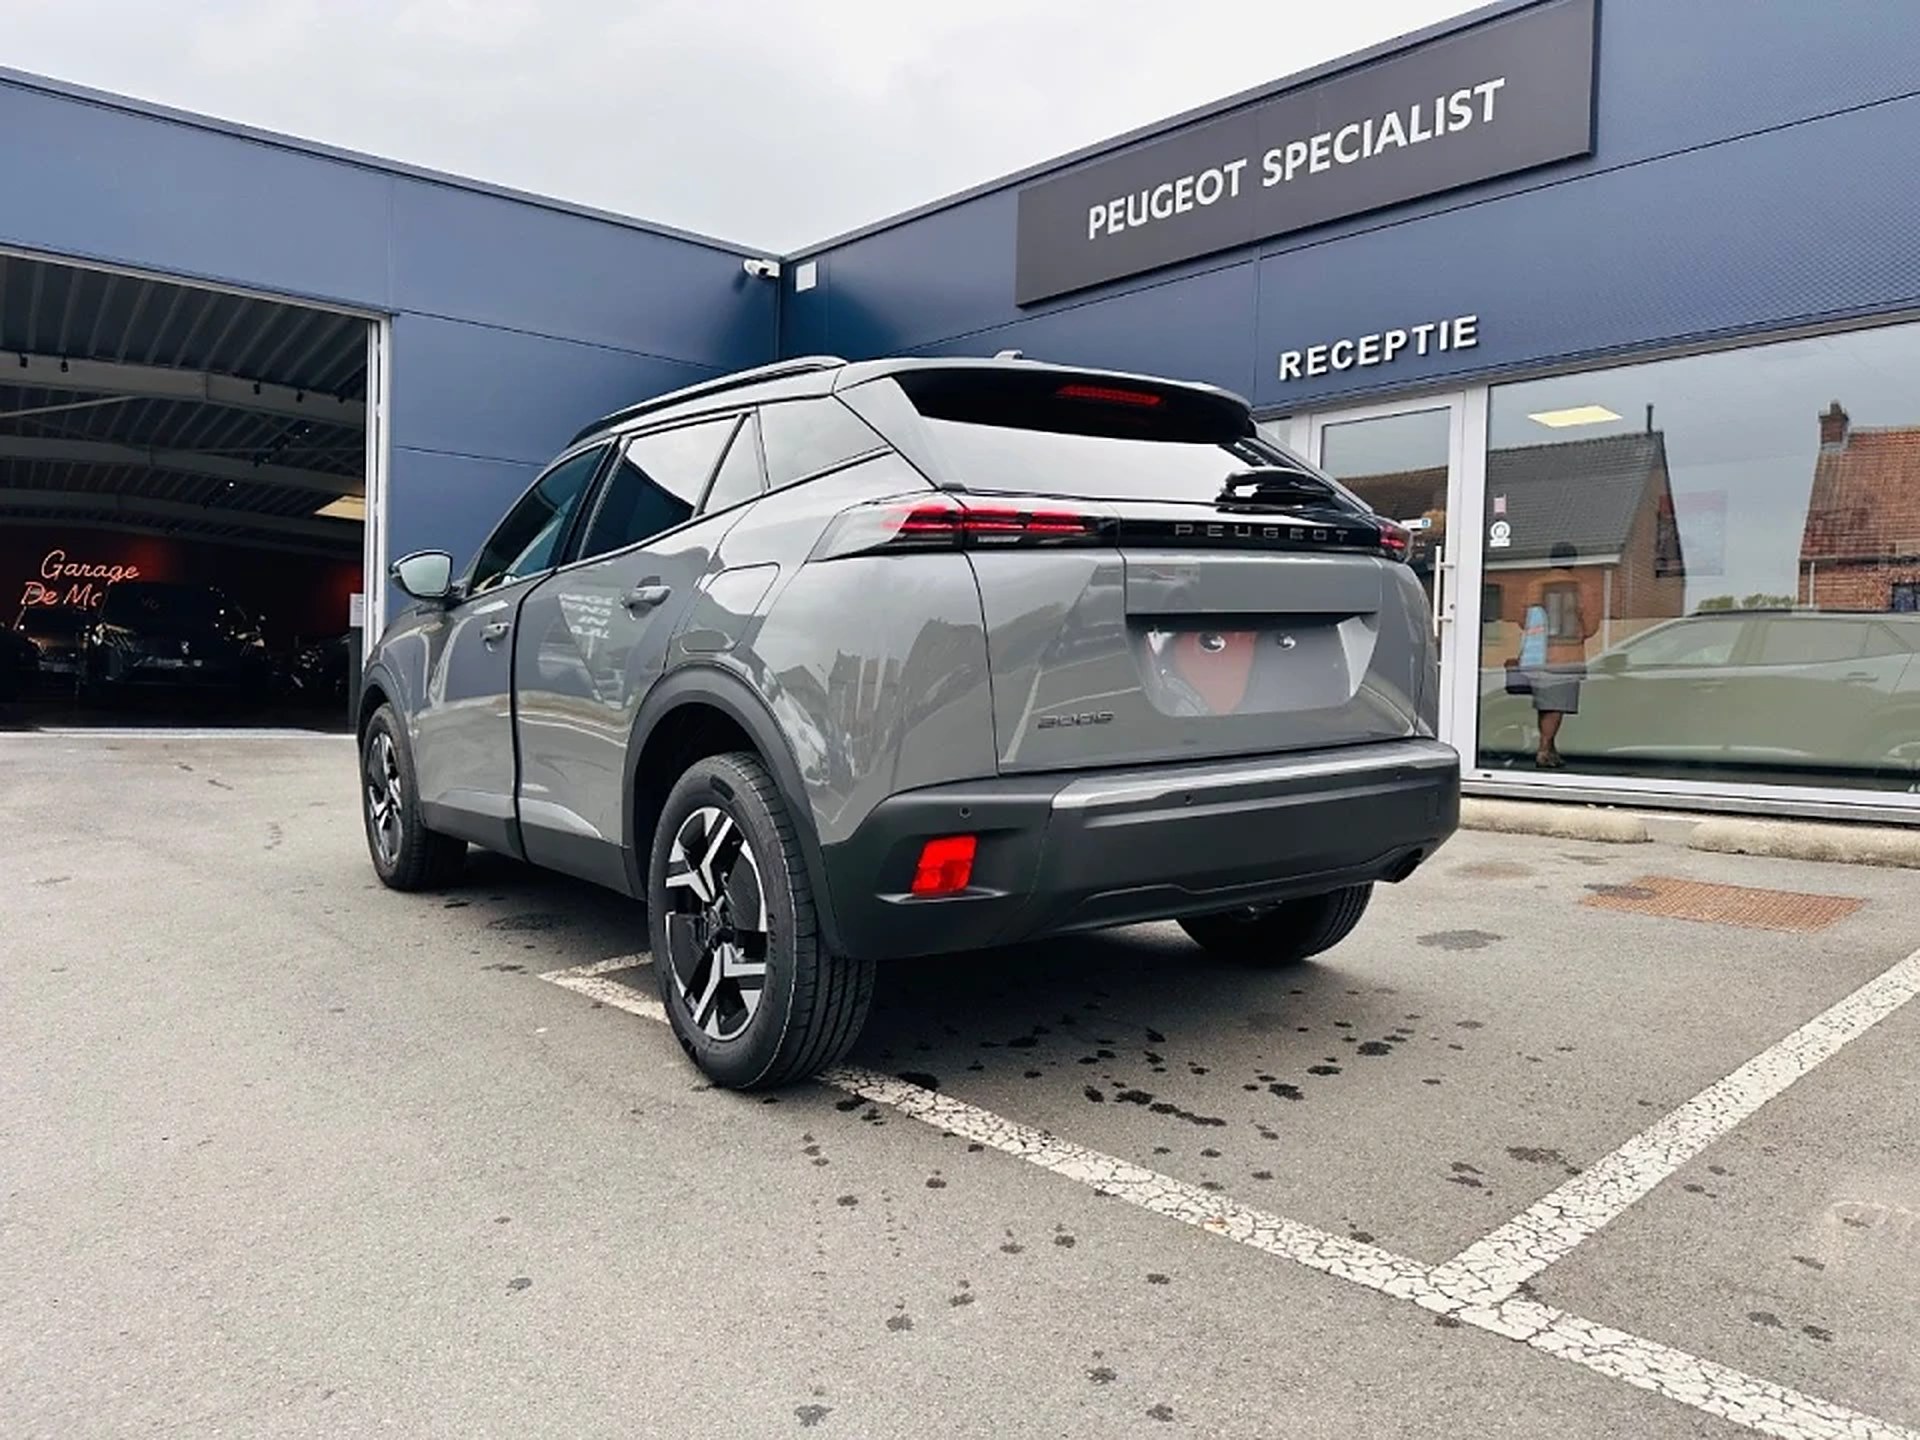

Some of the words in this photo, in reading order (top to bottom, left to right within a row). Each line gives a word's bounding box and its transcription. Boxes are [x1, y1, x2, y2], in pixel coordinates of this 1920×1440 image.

[1089, 158, 1247, 239] PEUGEOT
[1262, 78, 1505, 188] SPECIALIST
[1278, 315, 1479, 381] RECEPTIE
[1174, 523, 1348, 542] PEUGEOT
[40, 549, 141, 586] Garage
[20, 580, 59, 606] De
